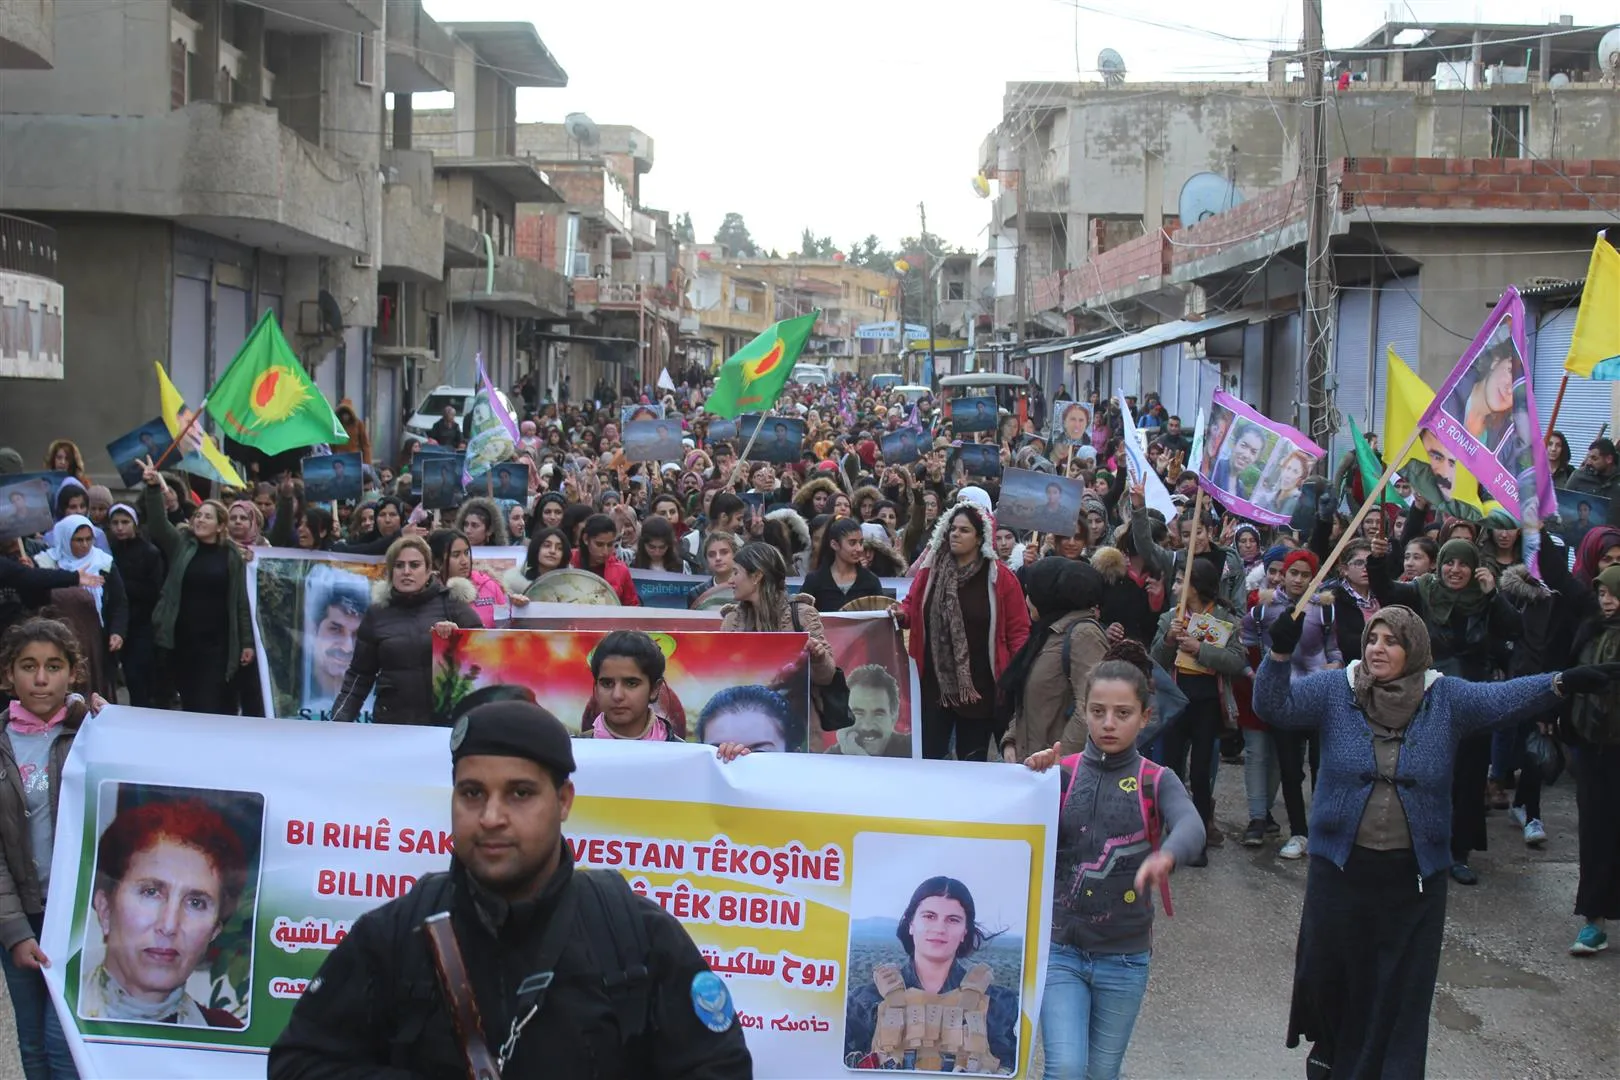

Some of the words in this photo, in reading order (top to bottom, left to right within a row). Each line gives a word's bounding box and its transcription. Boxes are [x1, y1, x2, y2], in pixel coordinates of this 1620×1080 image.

[286, 819, 315, 846] BI
[323, 817, 391, 851] RIHÊ
[693, 839, 840, 884] TÊKOŞÎNÊ
[655, 884, 711, 919] TÊK
[718, 895, 801, 926] BIBIN
[782, 955, 835, 987] بروح
